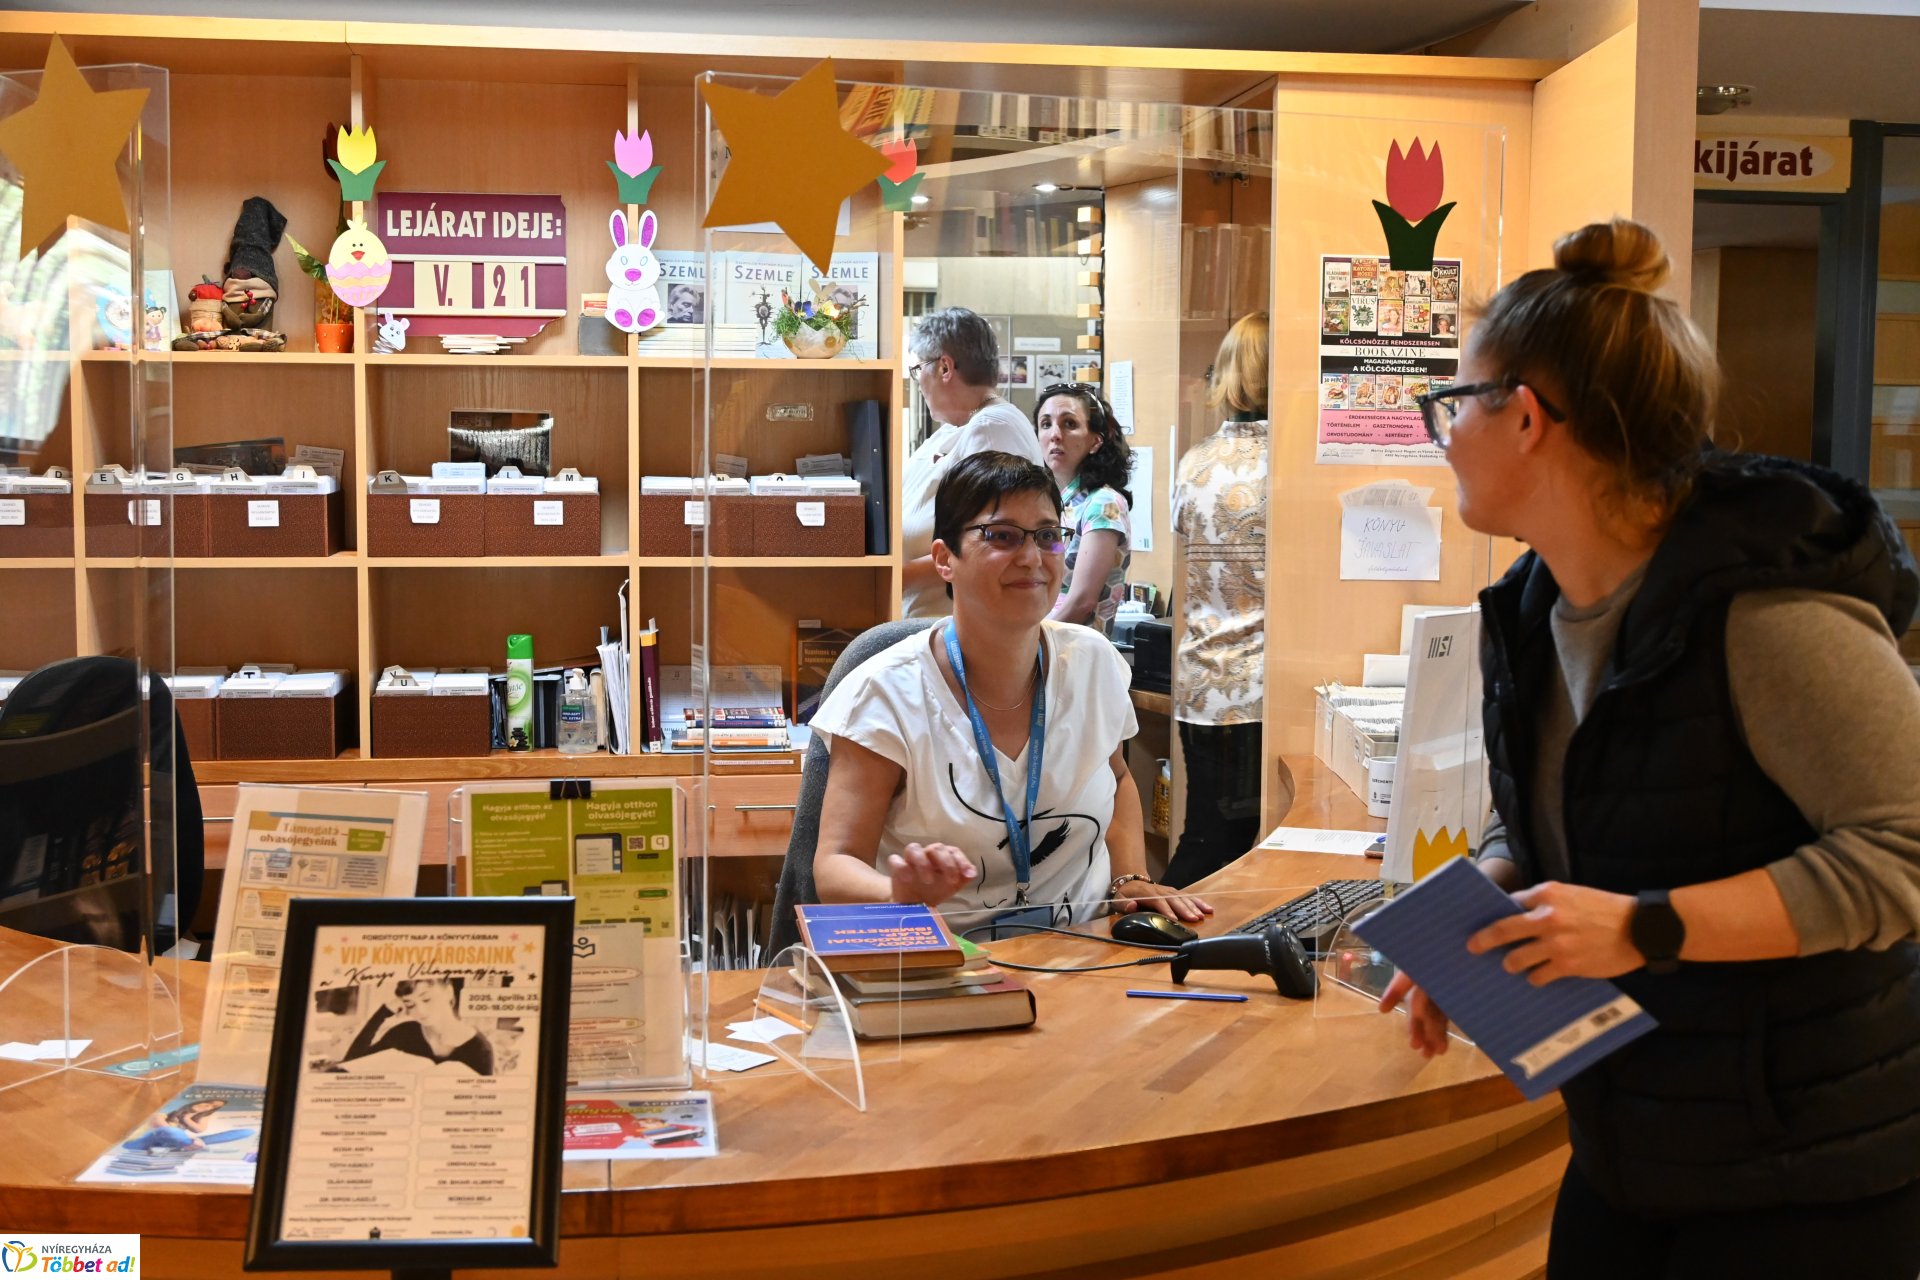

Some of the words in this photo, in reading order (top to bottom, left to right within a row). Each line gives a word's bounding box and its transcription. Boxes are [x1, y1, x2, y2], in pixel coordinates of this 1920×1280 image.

[1694, 140, 1813, 182] kijárat
[387, 202, 486, 238] LEJÁRAT
[493, 211, 562, 239] IDEJE:
[659, 263, 705, 279] SZEML
[734, 265, 793, 282] SZEMLE
[434, 264, 453, 306] V.
[1340, 338, 1389, 346] KÖLCSÖNÖZZE
[1390, 339, 1440, 347] RENDSZERESEN
[1355, 347, 1426, 357] BOOKAZINE
[1360, 364, 1427, 373] KÖLCSÖNZÉSBEN!
[55, 470, 63, 478] D
[100, 473, 107, 482] E
[176, 472, 184, 481] G
[230, 473, 238, 482] H
[565, 474, 574, 482] M
[384, 475, 393, 483] K
[243, 671, 255, 679] T
[400, 679, 407, 687] U
[586, 800, 621, 812] Hagyja
[624, 800, 657, 809] otthon
[588, 810, 657, 821] olvasójegyét!
[340, 946, 368, 965] VIP
[371, 942, 516, 964] KÖNYVTÁROSAINK
